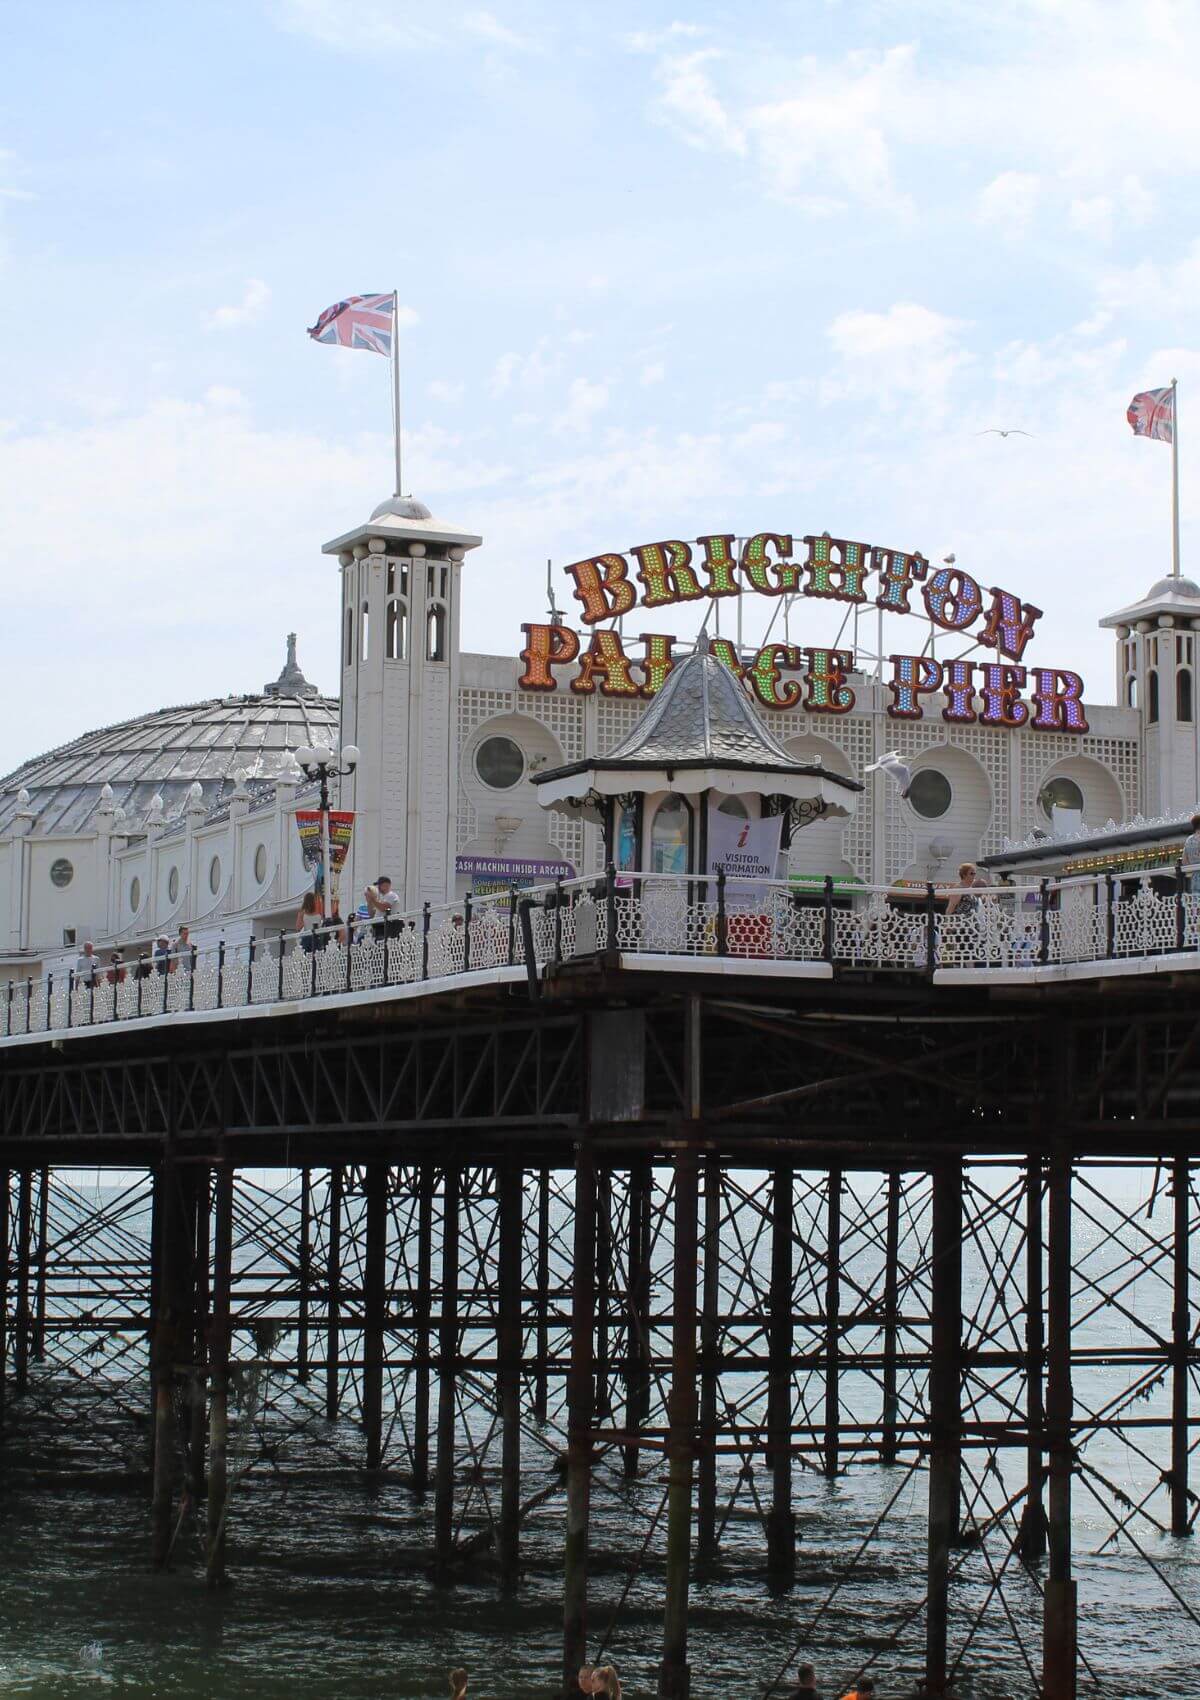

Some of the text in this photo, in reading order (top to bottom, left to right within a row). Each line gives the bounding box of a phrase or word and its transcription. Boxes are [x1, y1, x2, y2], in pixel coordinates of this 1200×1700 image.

[564, 533, 1043, 662] BRIGHTON
[889, 655, 1089, 734] PIER
[725, 853, 760, 864] VISITOR
[475, 862, 510, 873] MACHINE
[512, 864, 537, 874] INSIDE
[539, 865, 569, 876] ARCADE
[711, 862, 771, 874] INFORMATION
